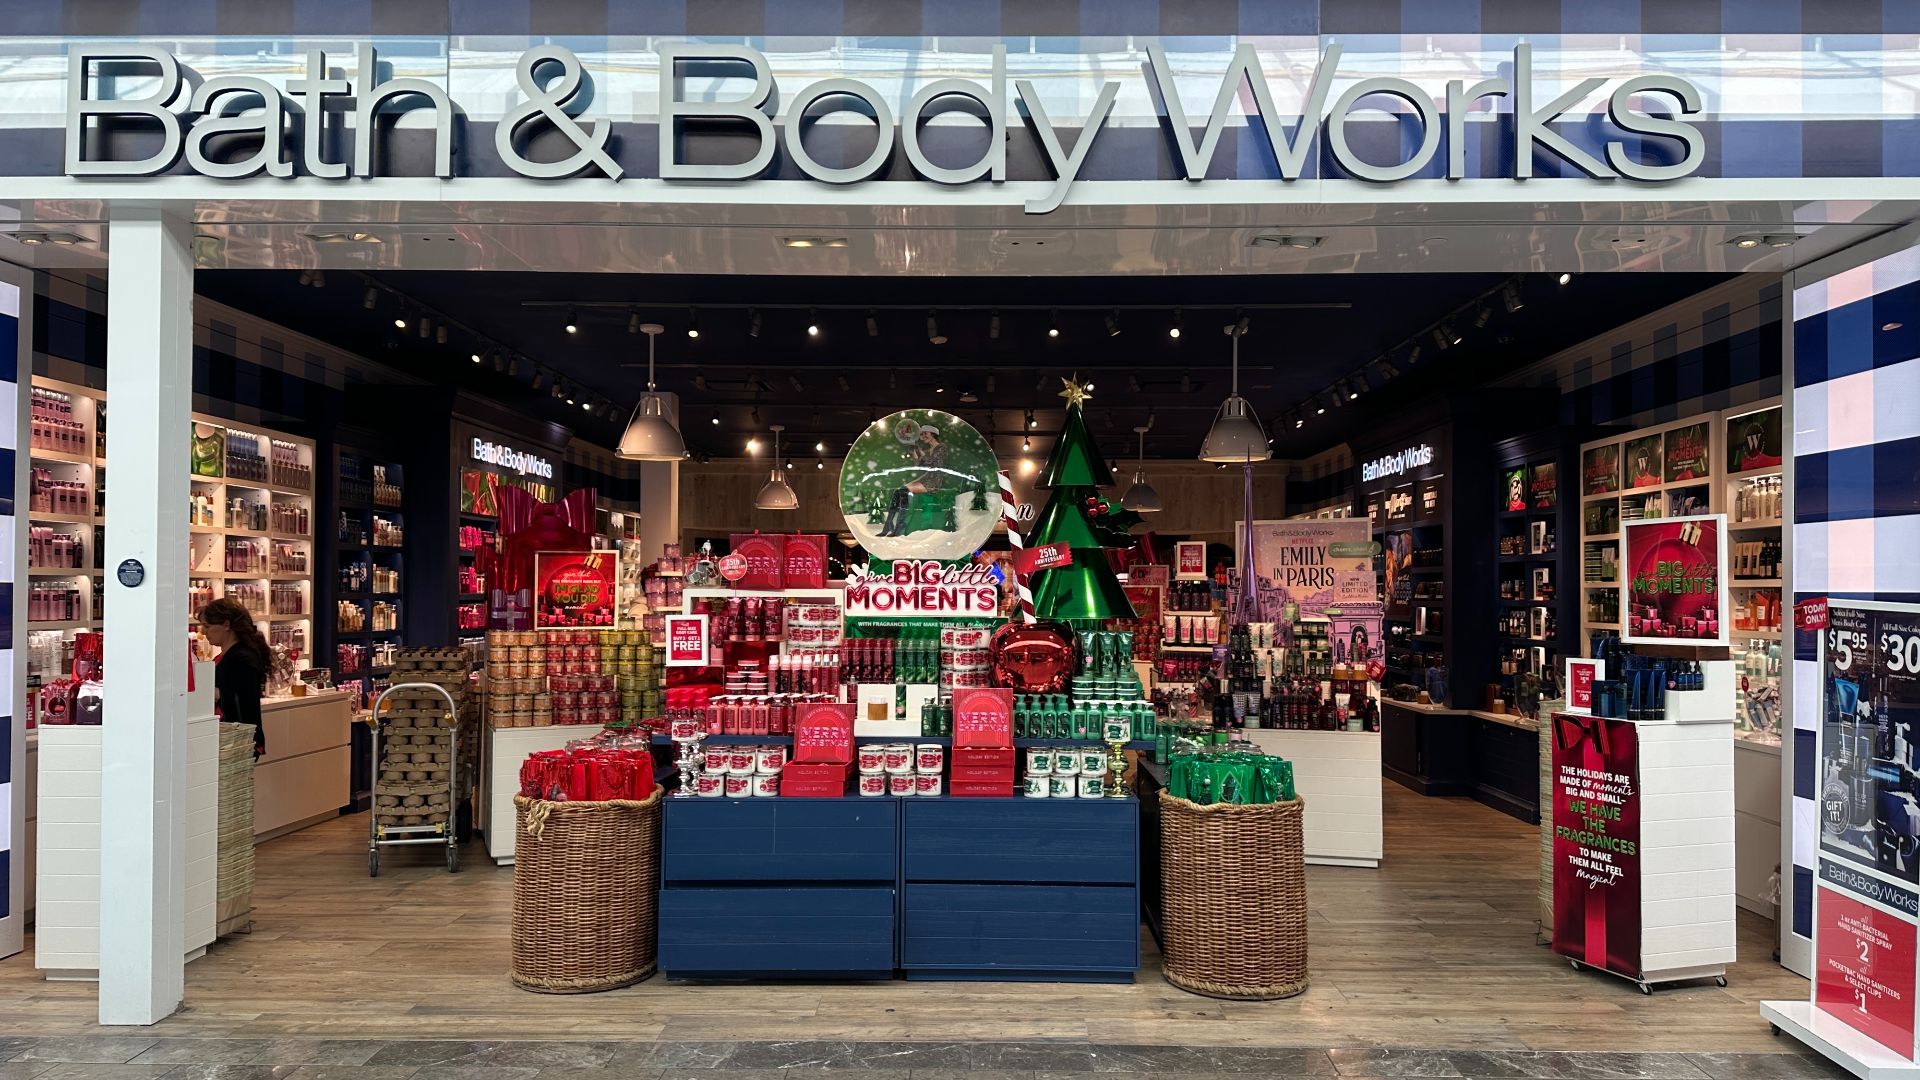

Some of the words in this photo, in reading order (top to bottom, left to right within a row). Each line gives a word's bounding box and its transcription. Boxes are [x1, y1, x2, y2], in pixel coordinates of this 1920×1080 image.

[65, 44, 454, 179] Bath
[495, 45, 625, 183] &
[659, 44, 1121, 214] Body
[1146, 44, 1706, 183] Works
[1038, 547, 1058, 559] 25th
[1181, 559, 1201, 567] FREE
[1280, 546, 1327, 566] EMILY
[856, 570, 893, 592] give
[893, 561, 941, 586] BIG
[940, 563, 998, 585] little
[1273, 567, 1283, 581] IN
[1286, 566, 1335, 589] PARIS
[1656, 560, 1683, 577] BIG
[1632, 576, 1715, 594] MOMENTS
[846, 587, 996, 611] MOMENTS
[1803, 603, 1827, 615] TODAY
[1805, 614, 1827, 625] ONLY!
[673, 640, 701, 652] FREE
[959, 711, 1009, 724] MERRY
[800, 726, 850, 739] MERRY
[1561, 765, 1576, 776] THE
[1576, 768, 1613, 781] HOLIDAYS
[1614, 775, 1630, 785] ARE
[1559, 776, 1581, 787] MADE
[1581, 779, 1592, 789] OF
[1592, 782, 1636, 796] moments
[1565, 786, 1579, 797] BIG
[1579, 790, 1596, 800] AND
[1568, 799, 1587, 815] WE
[1589, 803, 1622, 821] HAVE
[1826, 800, 1843, 812] GIFT
[1830, 810, 1841, 822] IT!
[1582, 816, 1606, 834] THE
[1556, 825, 1637, 856] FRAGRANCES
[1579, 847, 1590, 857] TO
[1590, 849, 1613, 863] MAKE
[1568, 855, 1590, 868] THEM
[1590, 860, 1605, 872] ALL
[1605, 865, 1624, 877] FEEL
[1837, 921, 1851, 932] HAND
[1851, 926, 1876, 943] SANITIZER
[1876, 936, 1893, 950] SPRAY
[1855, 938, 1869, 962] $2
[1828, 958, 1856, 977] POCKETBAC
[1856, 972, 1871, 985] HAND
[1870, 980, 1901, 1000] SANITIZERS
[1848, 977, 1867, 991] SELECT
[1866, 986, 1882, 999] CLIPS
[1854, 988, 1868, 1014] $1
